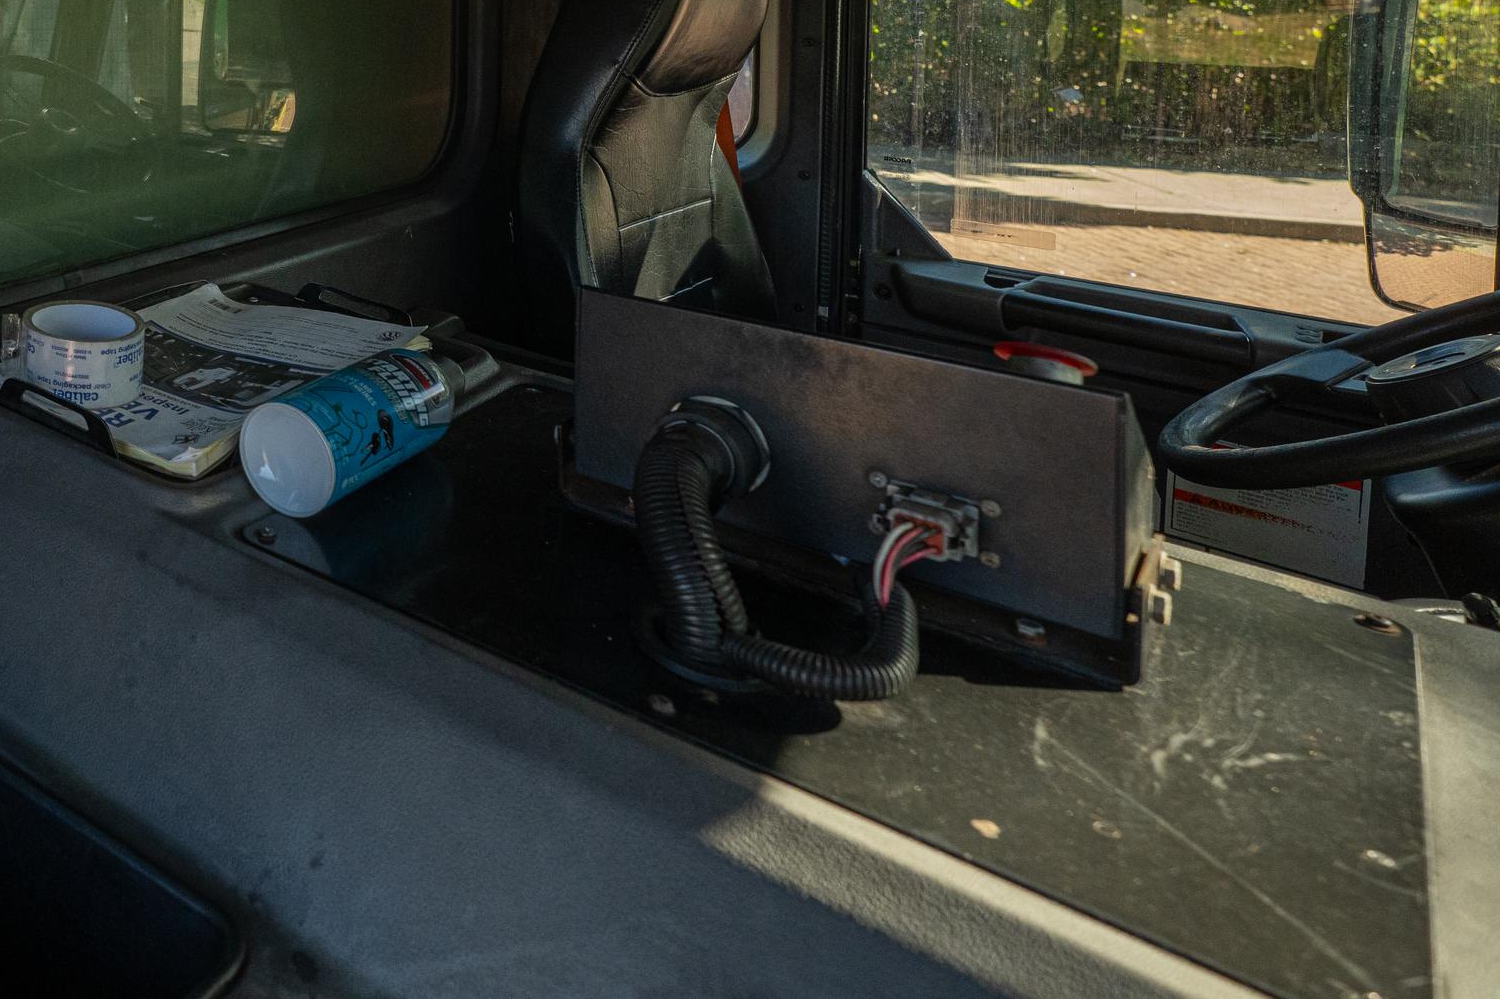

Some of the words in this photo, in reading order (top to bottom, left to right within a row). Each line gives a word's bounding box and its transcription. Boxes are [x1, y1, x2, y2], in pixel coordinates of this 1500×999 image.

[116, 349, 143, 366] aliber
[37, 375, 52, 384] tape
[52, 379, 92, 390] packaging
[366, 365, 417, 411] FLUID
[52, 388, 99, 405] caliber
